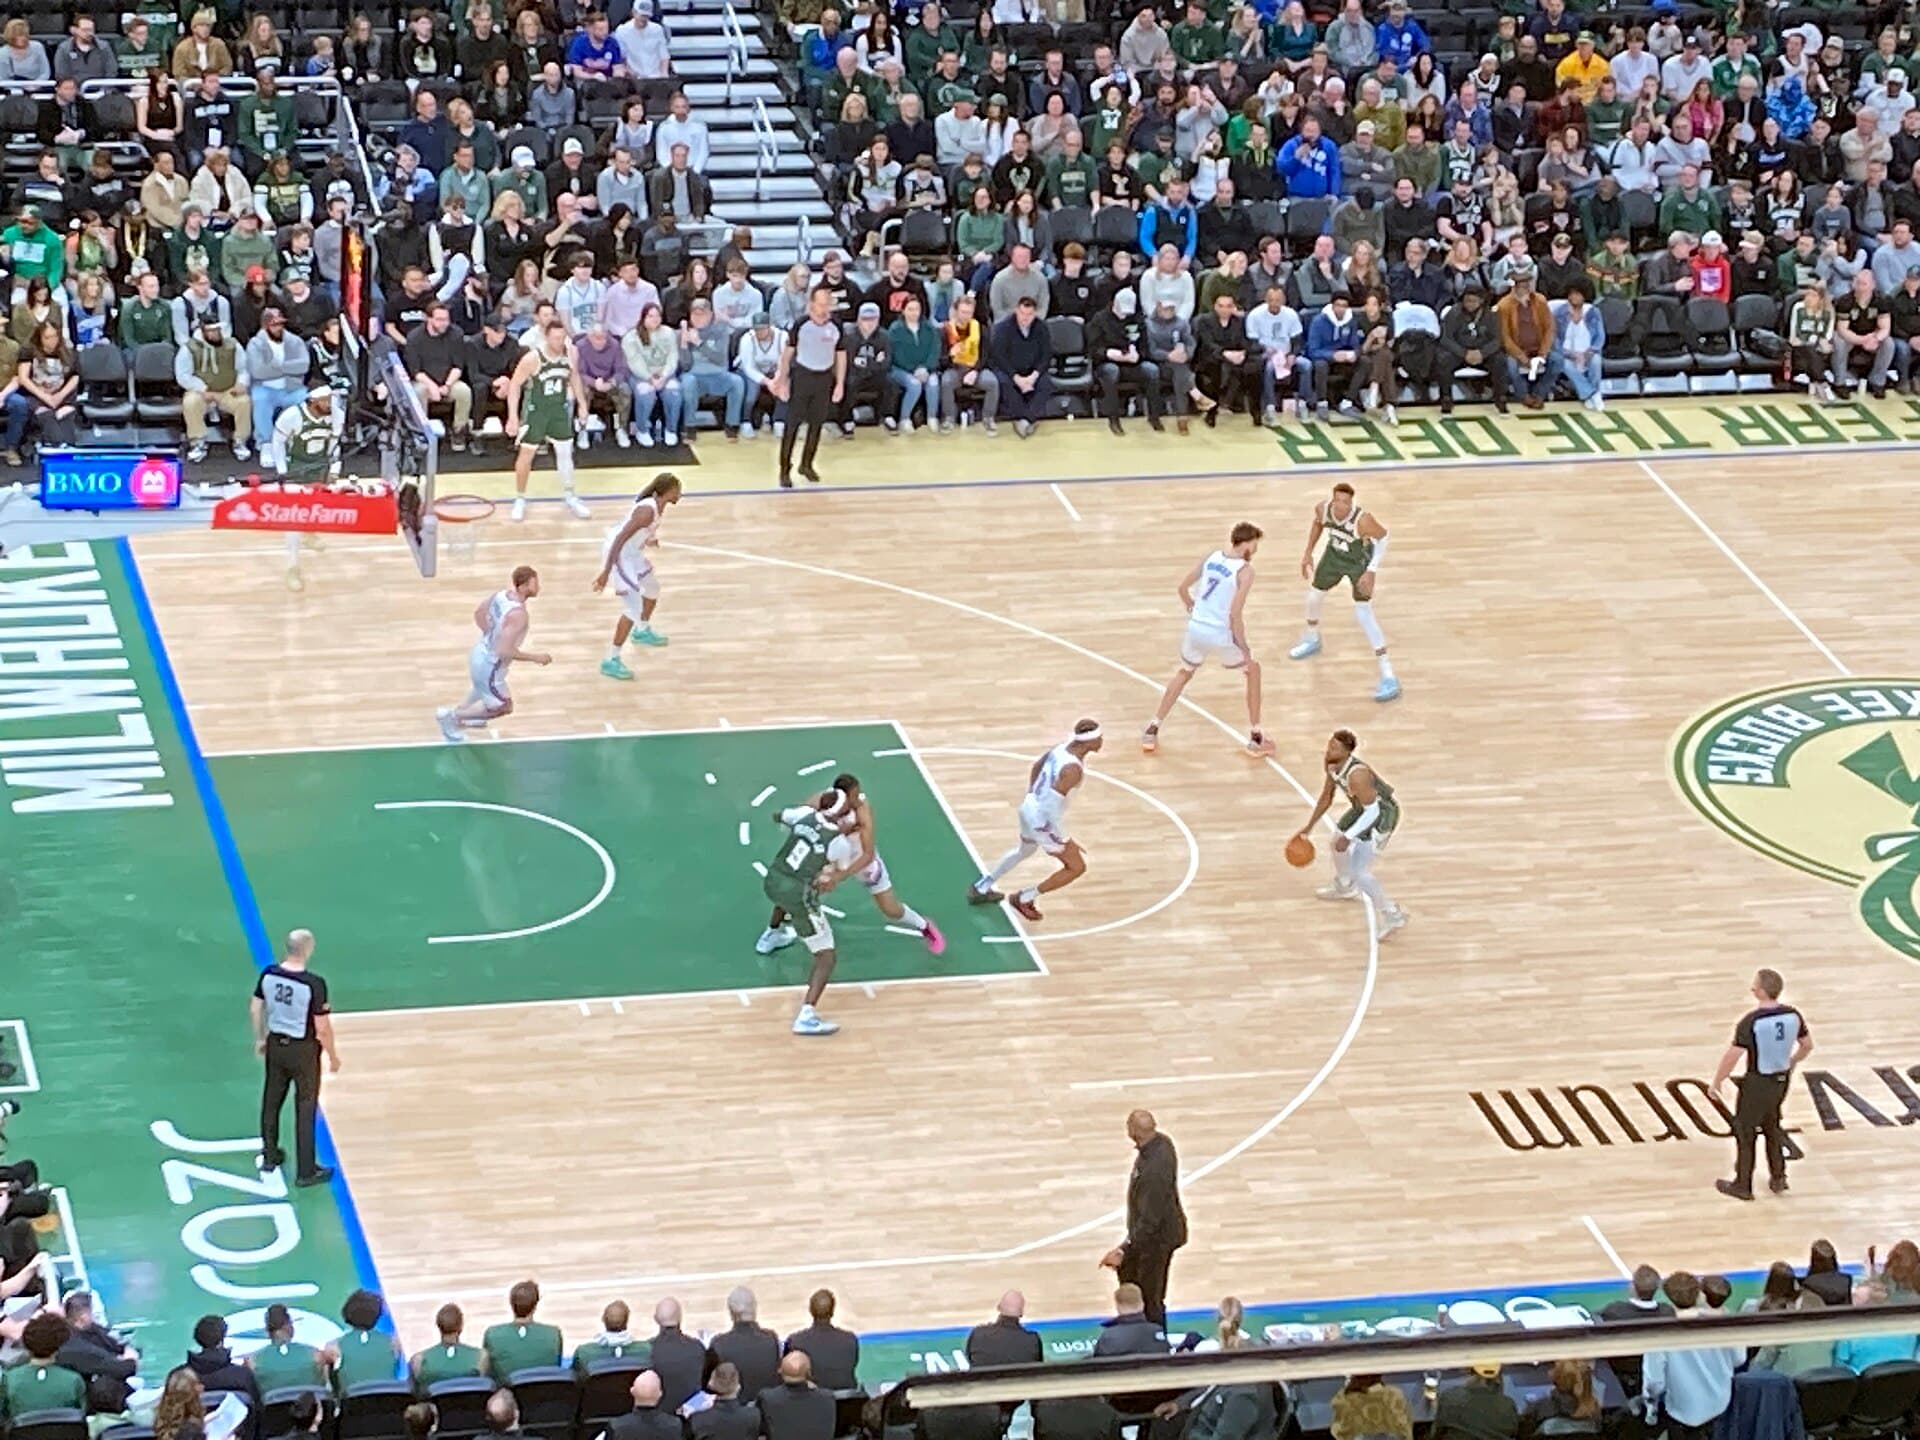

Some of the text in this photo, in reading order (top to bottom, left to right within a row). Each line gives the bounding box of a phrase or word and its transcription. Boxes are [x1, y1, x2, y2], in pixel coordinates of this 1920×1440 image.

[1265, 415, 1522, 463] DEER
[1515, 409, 1712, 453] THE
[46, 472, 122, 494] BMO
[1201, 577, 1220, 600] 7
[0, 541, 174, 813] MILWAUKE
[1707, 689, 1920, 784] KEE BUCKS
[151, 1120, 319, 1300] razr
